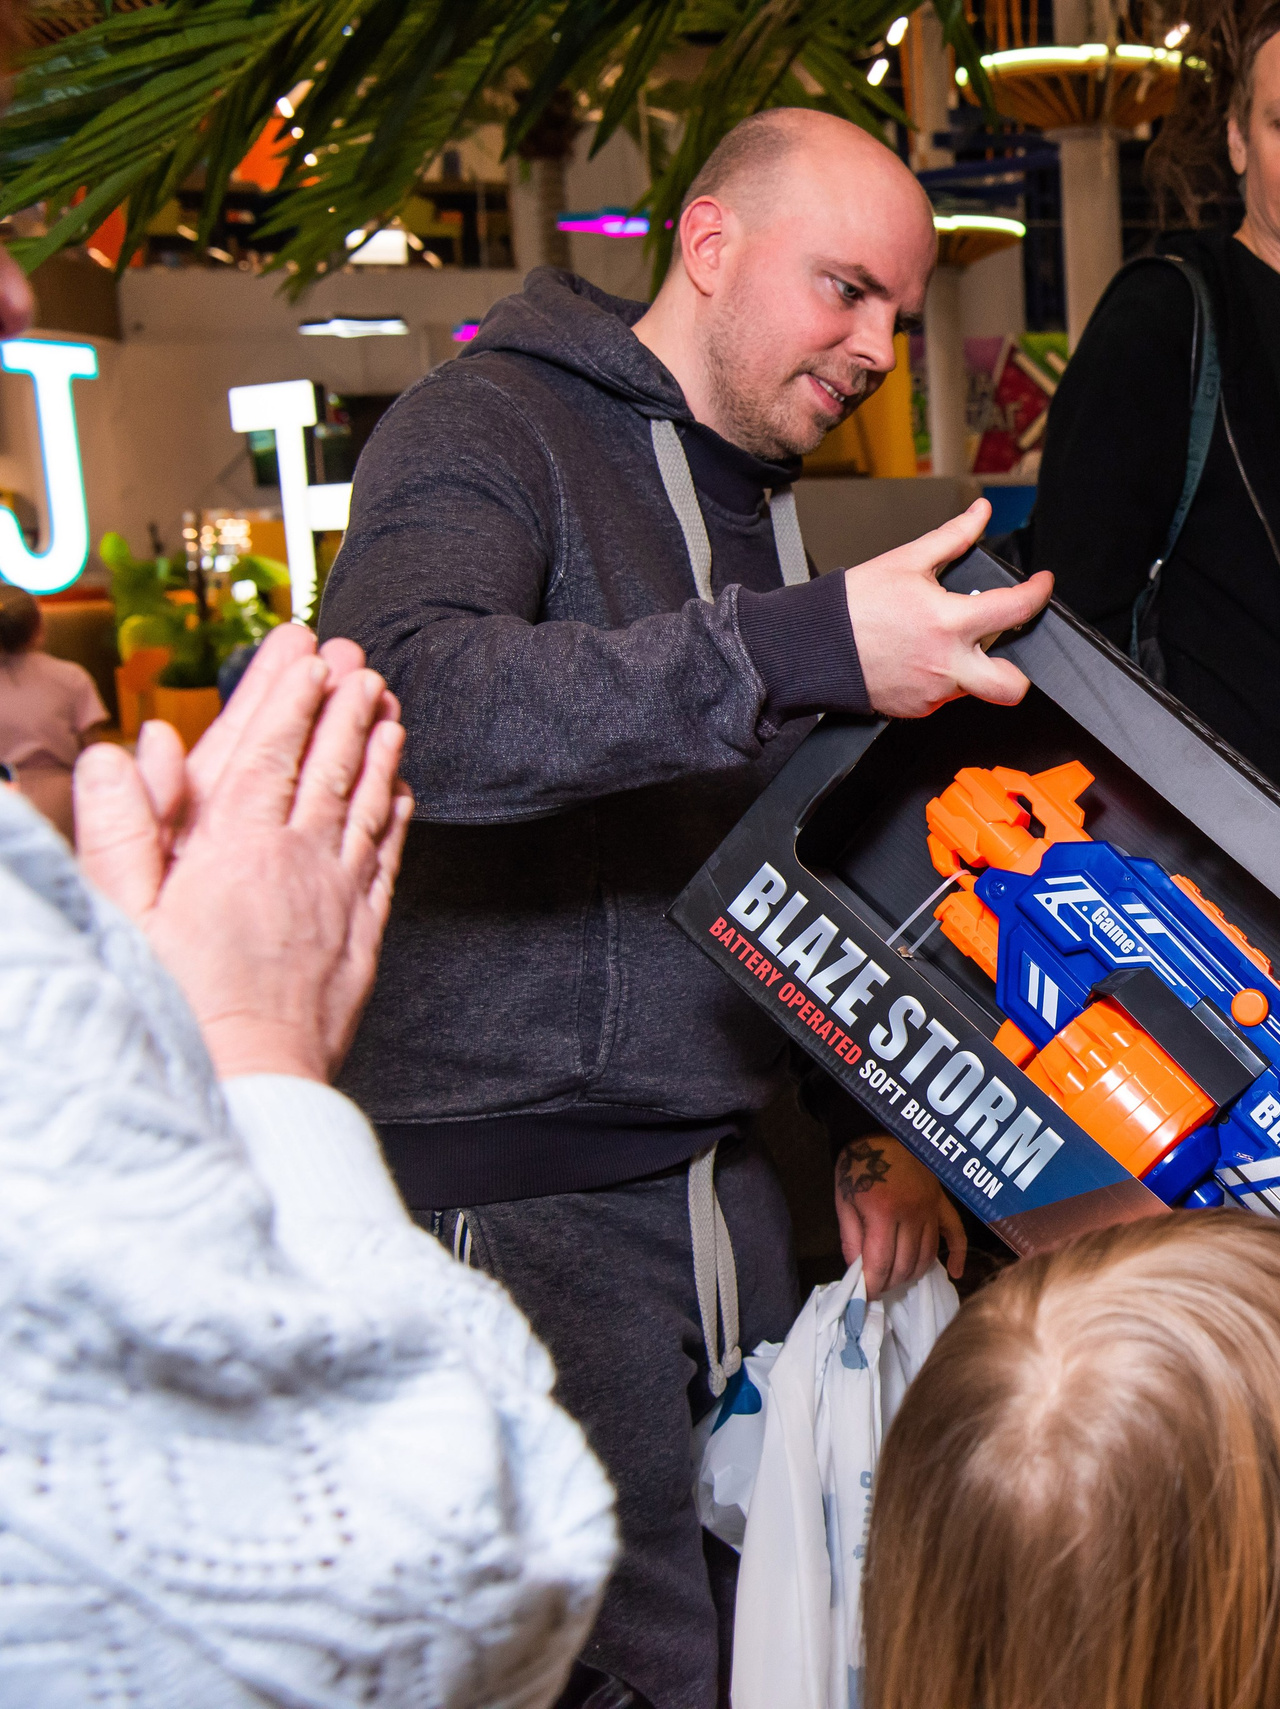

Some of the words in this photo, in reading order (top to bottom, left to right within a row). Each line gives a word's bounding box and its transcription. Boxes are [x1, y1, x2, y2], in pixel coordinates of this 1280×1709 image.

[709, 916, 783, 987] BATTERY
[778, 982, 863, 1065] OPERATED
[859, 1059, 907, 1105] SOFT
[900, 1098, 967, 1163] BULLET
[962, 1157, 1004, 1200] GUN
[727, 861, 891, 1028] BLAZE
[868, 995, 1065, 1192] STORM
[1091, 906, 1135, 954] Game
